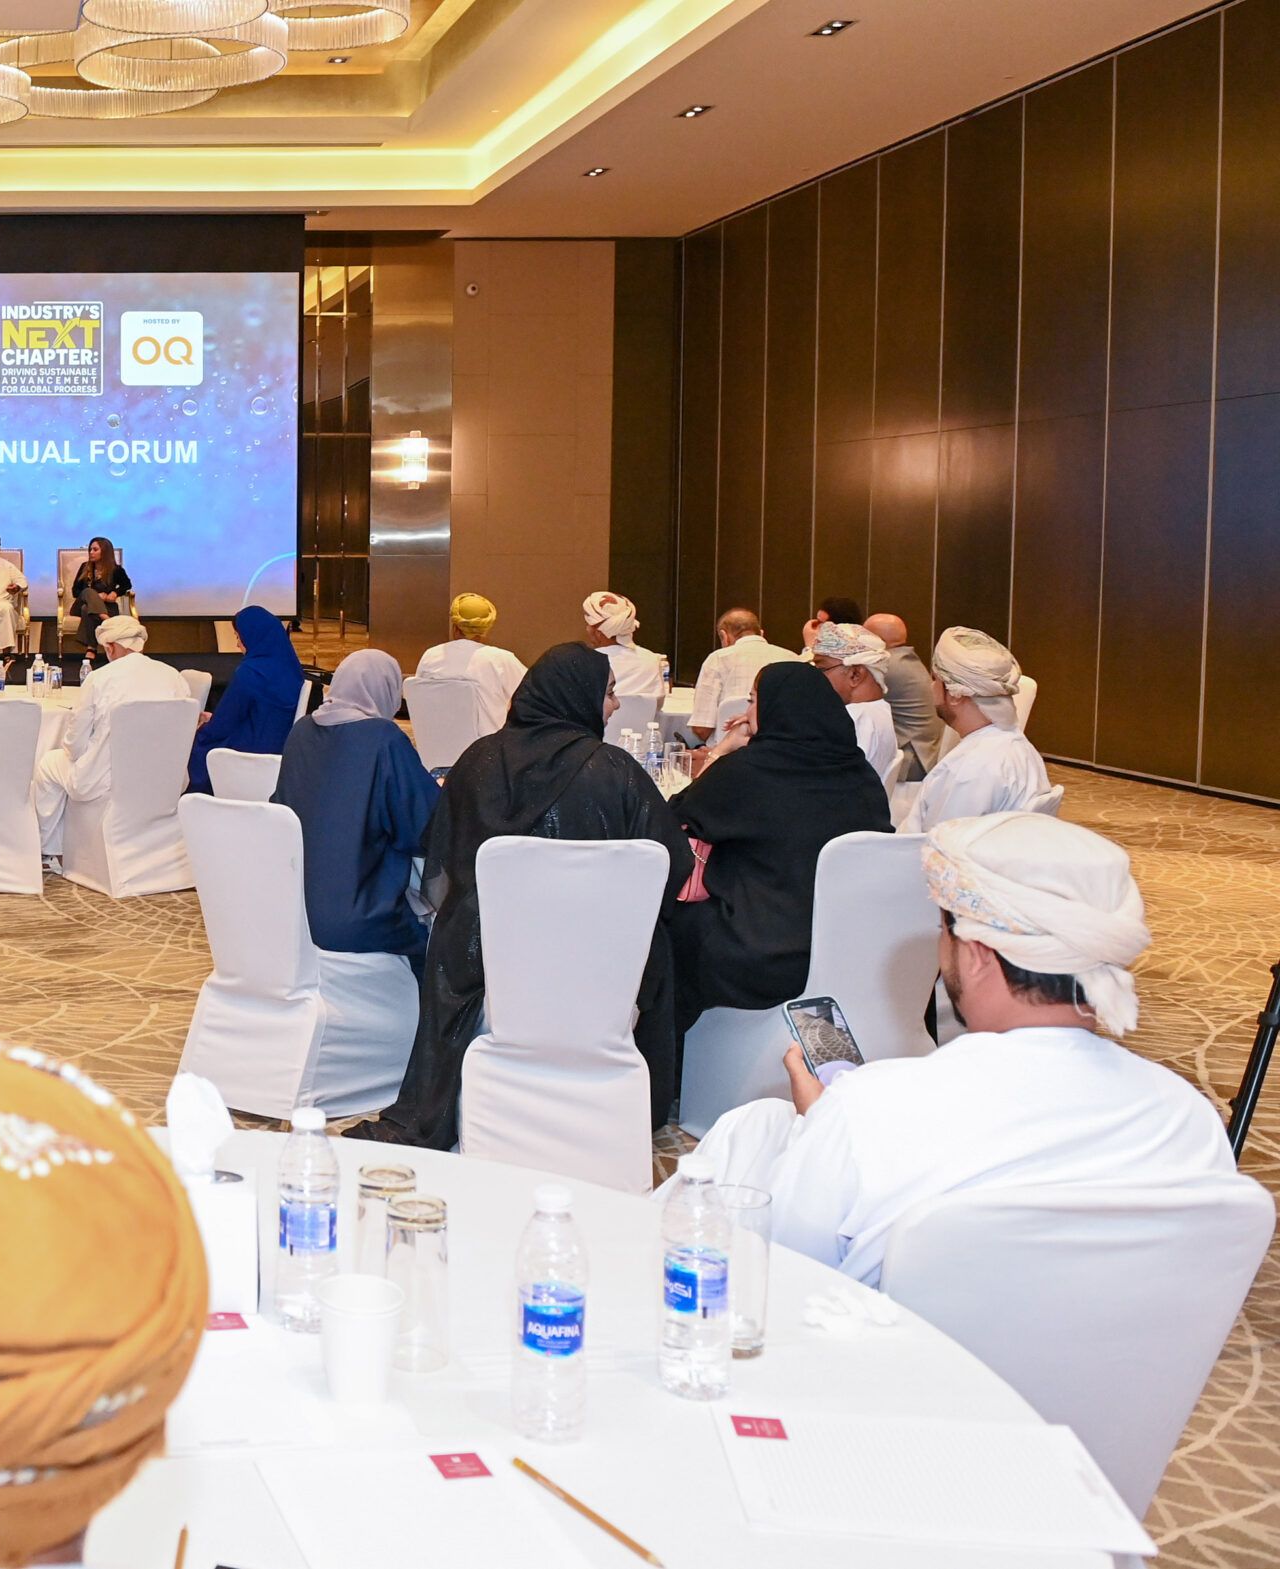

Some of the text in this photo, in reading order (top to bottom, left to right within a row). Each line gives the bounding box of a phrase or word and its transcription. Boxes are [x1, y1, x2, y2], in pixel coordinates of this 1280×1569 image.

[1, 305, 100, 320] INDUSTRY'S
[2, 318, 100, 349] NEXT
[1, 349, 99, 366] CHAPTER:
[131, 336, 194, 365] OQ
[1, 368, 97, 376] DRIVING SUSTAINABLE
[1, 376, 97, 385] ADVANCEMENT
[1, 385, 97, 394] FOR GLOBAL PROGRESS
[89, 440, 198, 465] FORUM
[526, 1321, 580, 1340] AQUAFINA
